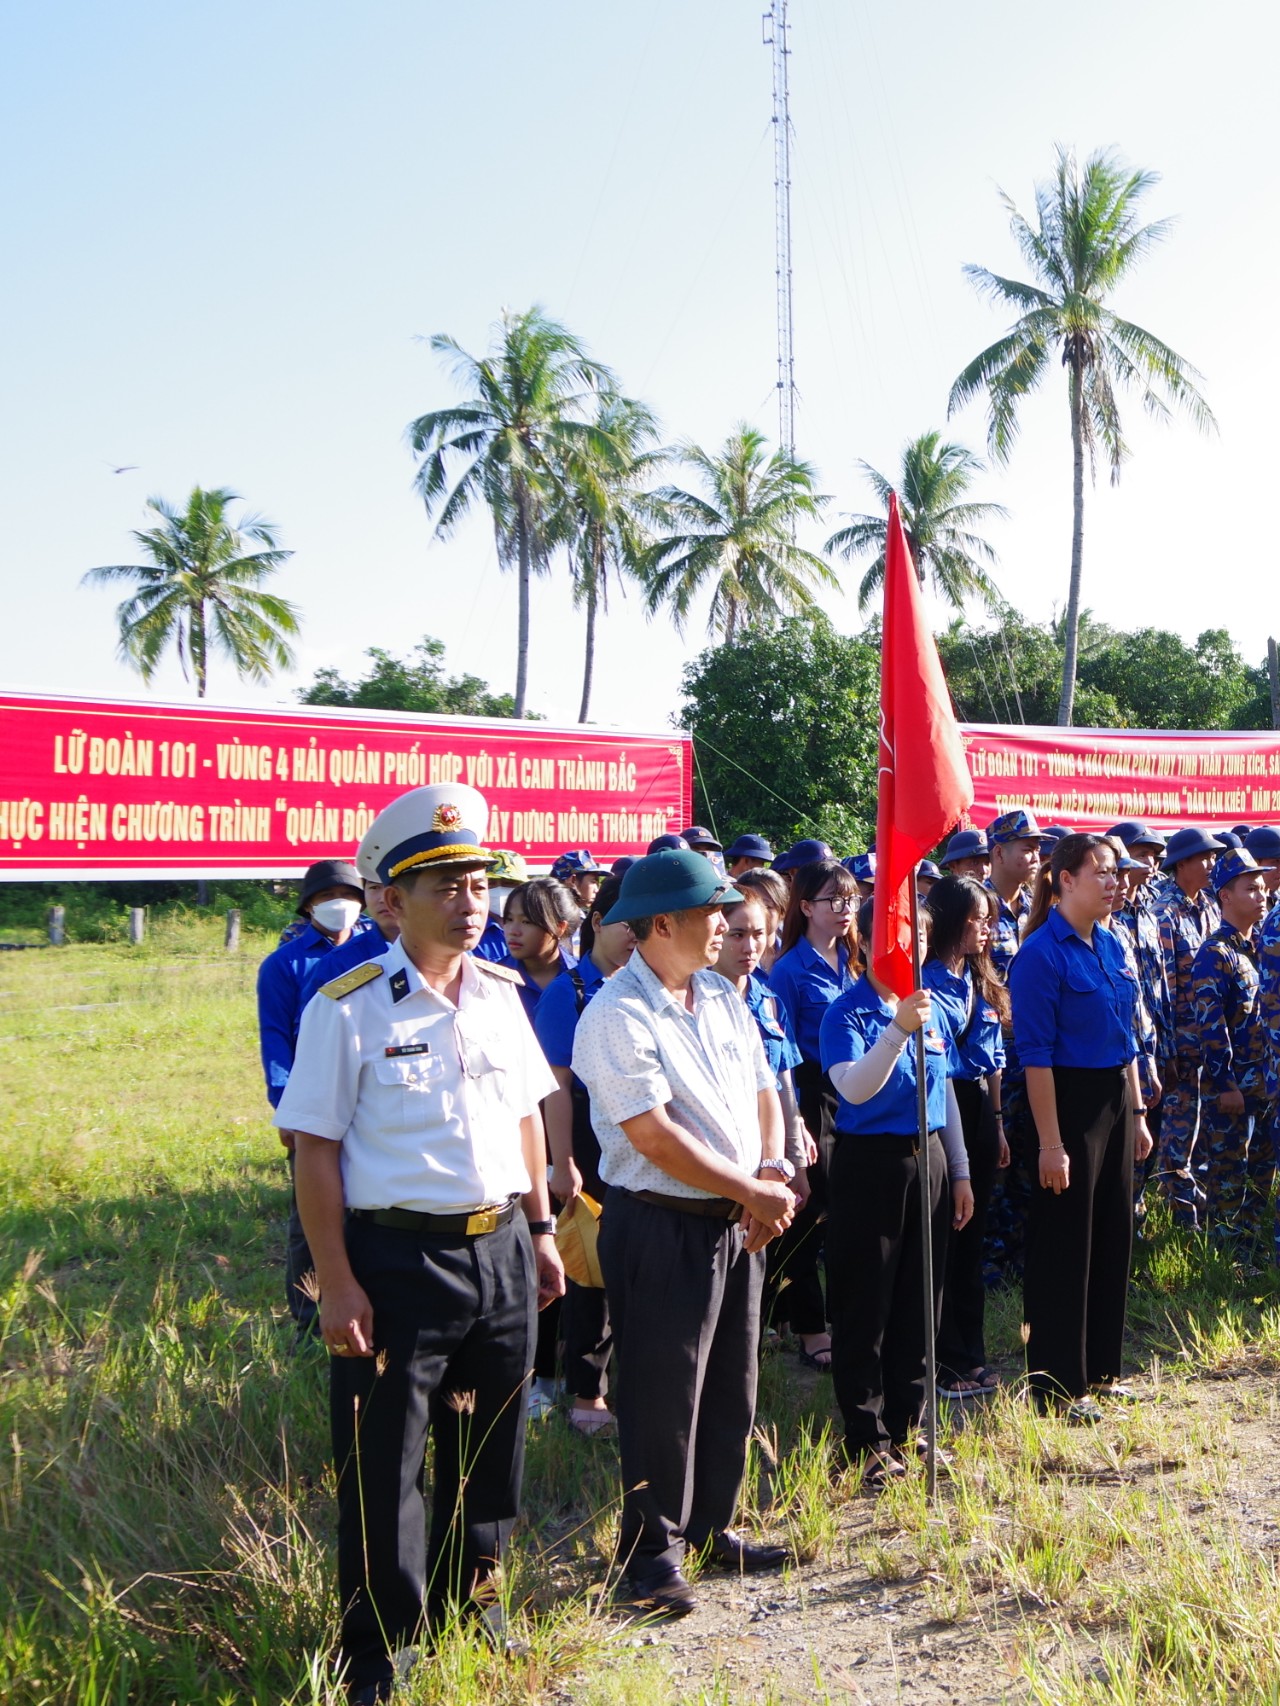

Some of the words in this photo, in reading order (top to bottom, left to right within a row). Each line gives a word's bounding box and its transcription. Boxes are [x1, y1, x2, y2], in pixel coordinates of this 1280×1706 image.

[54, 729, 87, 774] LỮ
[90, 731, 153, 777] ĐOÀN
[159, 742, 197, 778] 101
[203, 758, 212, 768] -
[216, 736, 272, 780] VÙNG
[275, 747, 289, 781] 4
[292, 736, 325, 783] HẢI
[330, 744, 380, 787] QUÂN
[384, 742, 426, 786] PHỐI
[466, 750, 492, 788] VỚI
[496, 752, 518, 788] XÃ
[520, 758, 554, 790] CAM
[558, 754, 605, 791] THÀNH
[608, 751, 636, 792] BẮC
[987, 748, 1018, 776] ĐOÀN
[1020, 753, 1038, 776] 101
[1047, 749, 1076, 776] VÙNG
[1104, 749, 1130, 779] QUÂN
[1131, 749, 1158, 776] PHÁT
[1158, 754, 1178, 776] HUY
[1223, 754, 1246, 776] XUNG
[1246, 750, 1268, 778] KÍCH,
[49, 795, 107, 850] HIỆN
[111, 800, 204, 842] CHƯƠNG
[208, 798, 270, 842] TRÌNH
[276, 798, 339, 846] “QUÂN
[513, 808, 554, 850] DỰNG
[558, 806, 598, 843] NÔNG
[602, 807, 638, 843] THÔN
[1061, 788, 1086, 822] HIỆN
[1087, 794, 1120, 816] PHONG
[1121, 788, 1144, 815] TRÀO
[1146, 792, 1160, 814] THI
[1162, 792, 1180, 814] ĐUA
[1206, 787, 1224, 818] VẬN
[1252, 786, 1270, 812] NĂM
